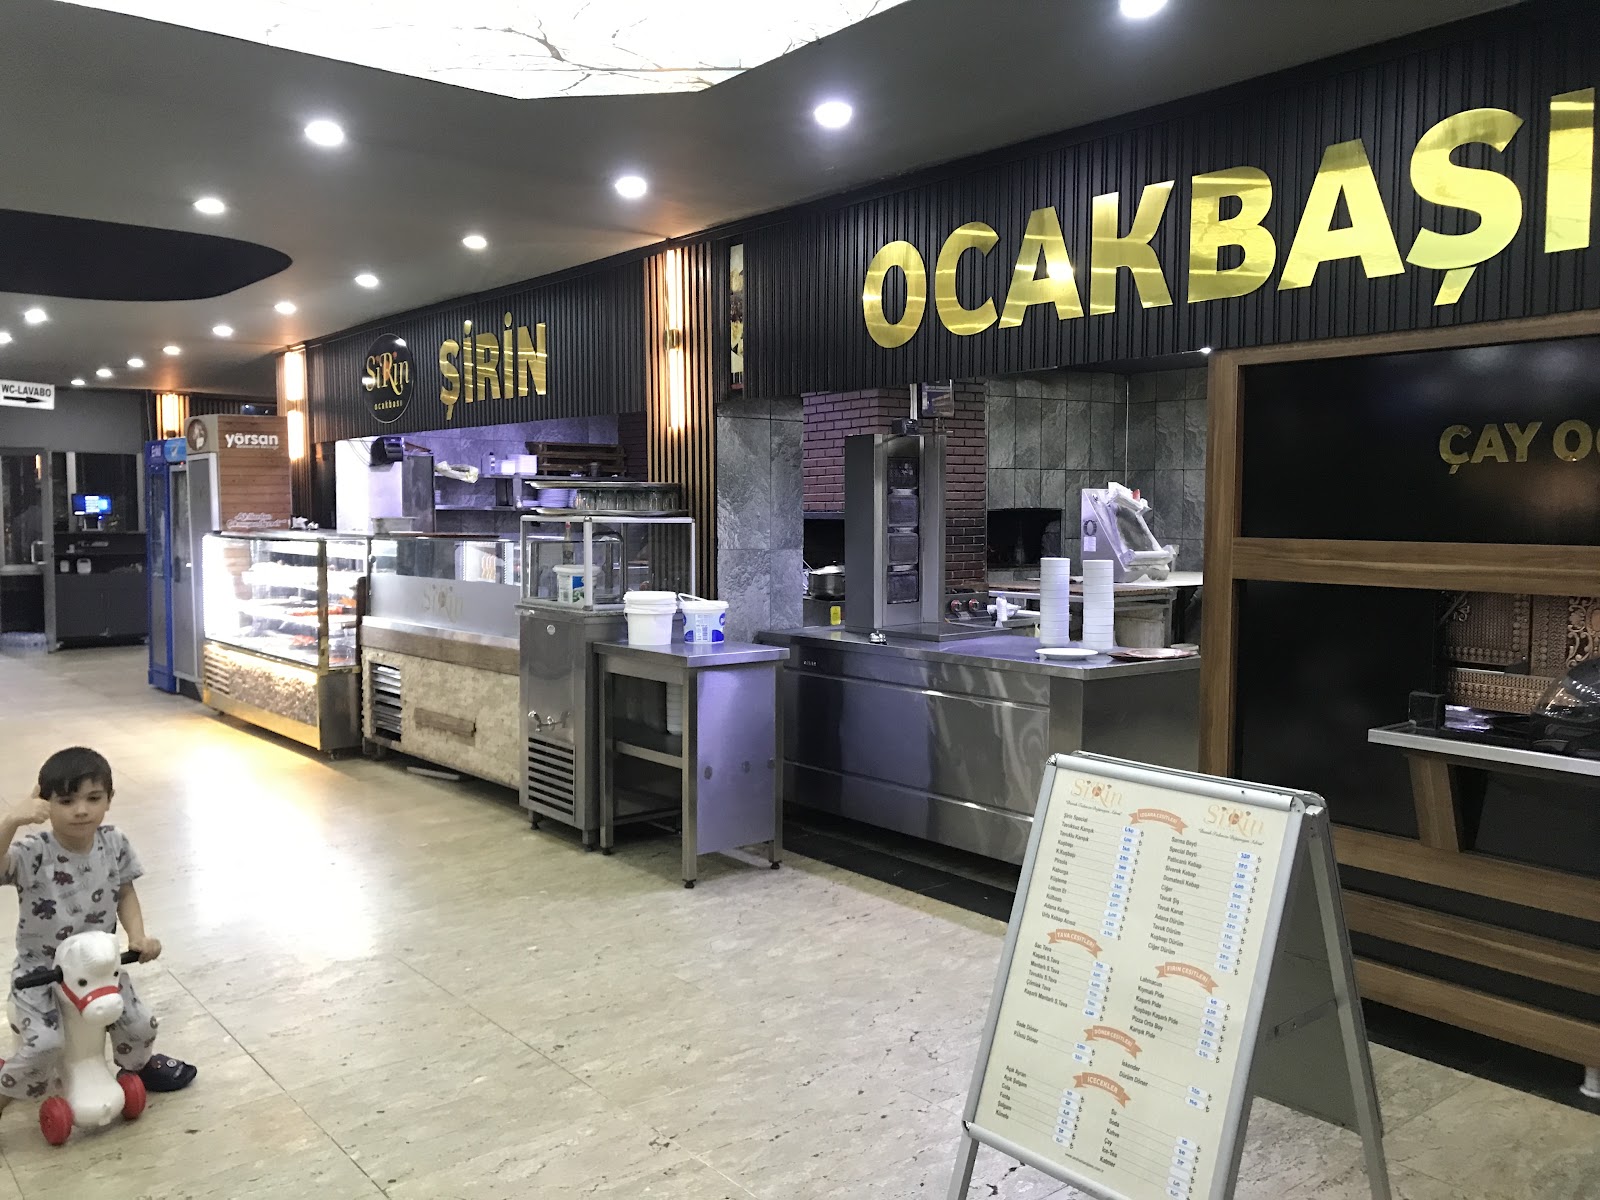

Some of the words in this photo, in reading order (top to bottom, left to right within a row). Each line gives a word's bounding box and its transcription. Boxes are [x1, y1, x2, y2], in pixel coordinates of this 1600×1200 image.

[862, 87, 1595, 348] OCAKBAŞI
[439, 312, 547, 420] ŞİRİN
[2, 384, 52, 397] WC-LAVABO
[225, 433, 279, 448] yörsan
[1439, 424, 1542, 474] ÇAY
[1553, 420, 1600, 461] O
[1132, 1015, 1143, 1024] Pizza
[1154, 1023, 1163, 1031] Boy
[1168, 1017, 1178, 1025] Pide
